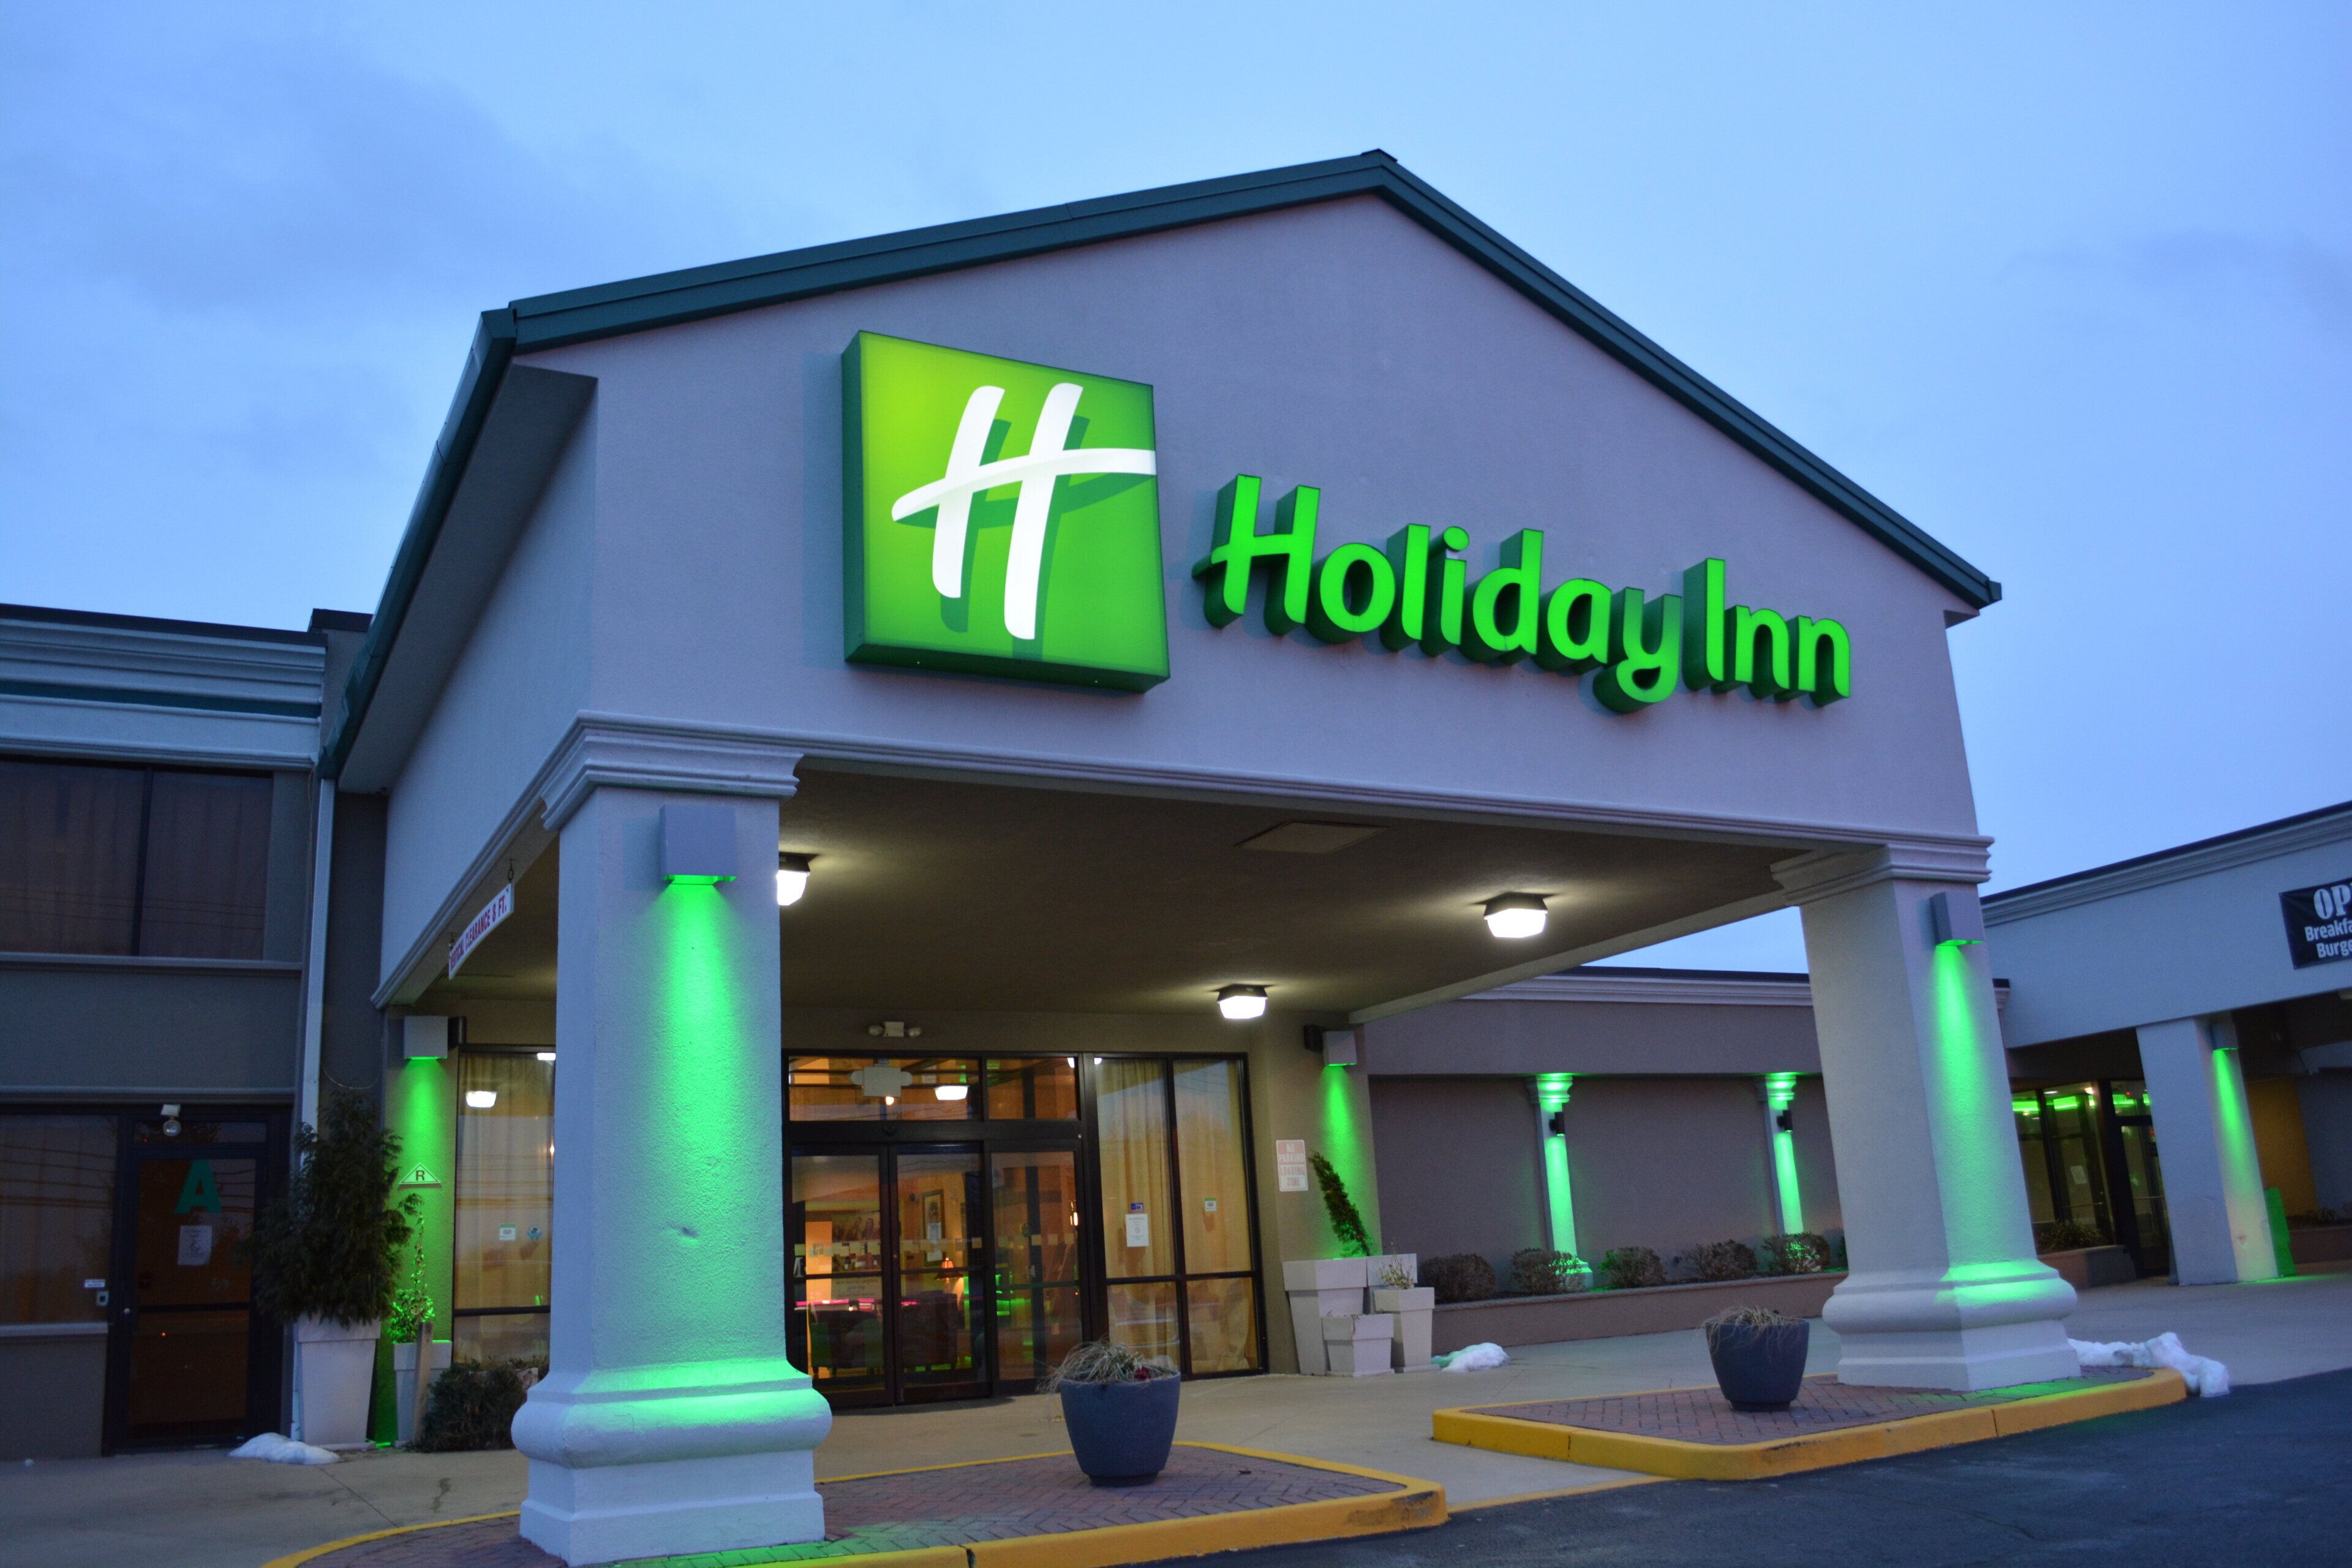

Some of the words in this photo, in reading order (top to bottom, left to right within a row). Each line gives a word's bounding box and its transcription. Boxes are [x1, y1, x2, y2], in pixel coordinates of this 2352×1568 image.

[1207, 473, 1682, 704] Holiday
[1700, 558, 1851, 699] Inn
[2313, 882, 2352, 919] OP
[492, 902, 496, 923] 8
[1279, 1153, 1305, 1163] PARKING
[416, 1170, 425, 1181] R
[1280, 1166, 1305, 1175] LOADING
[1287, 1177, 1300, 1186] ZONE
